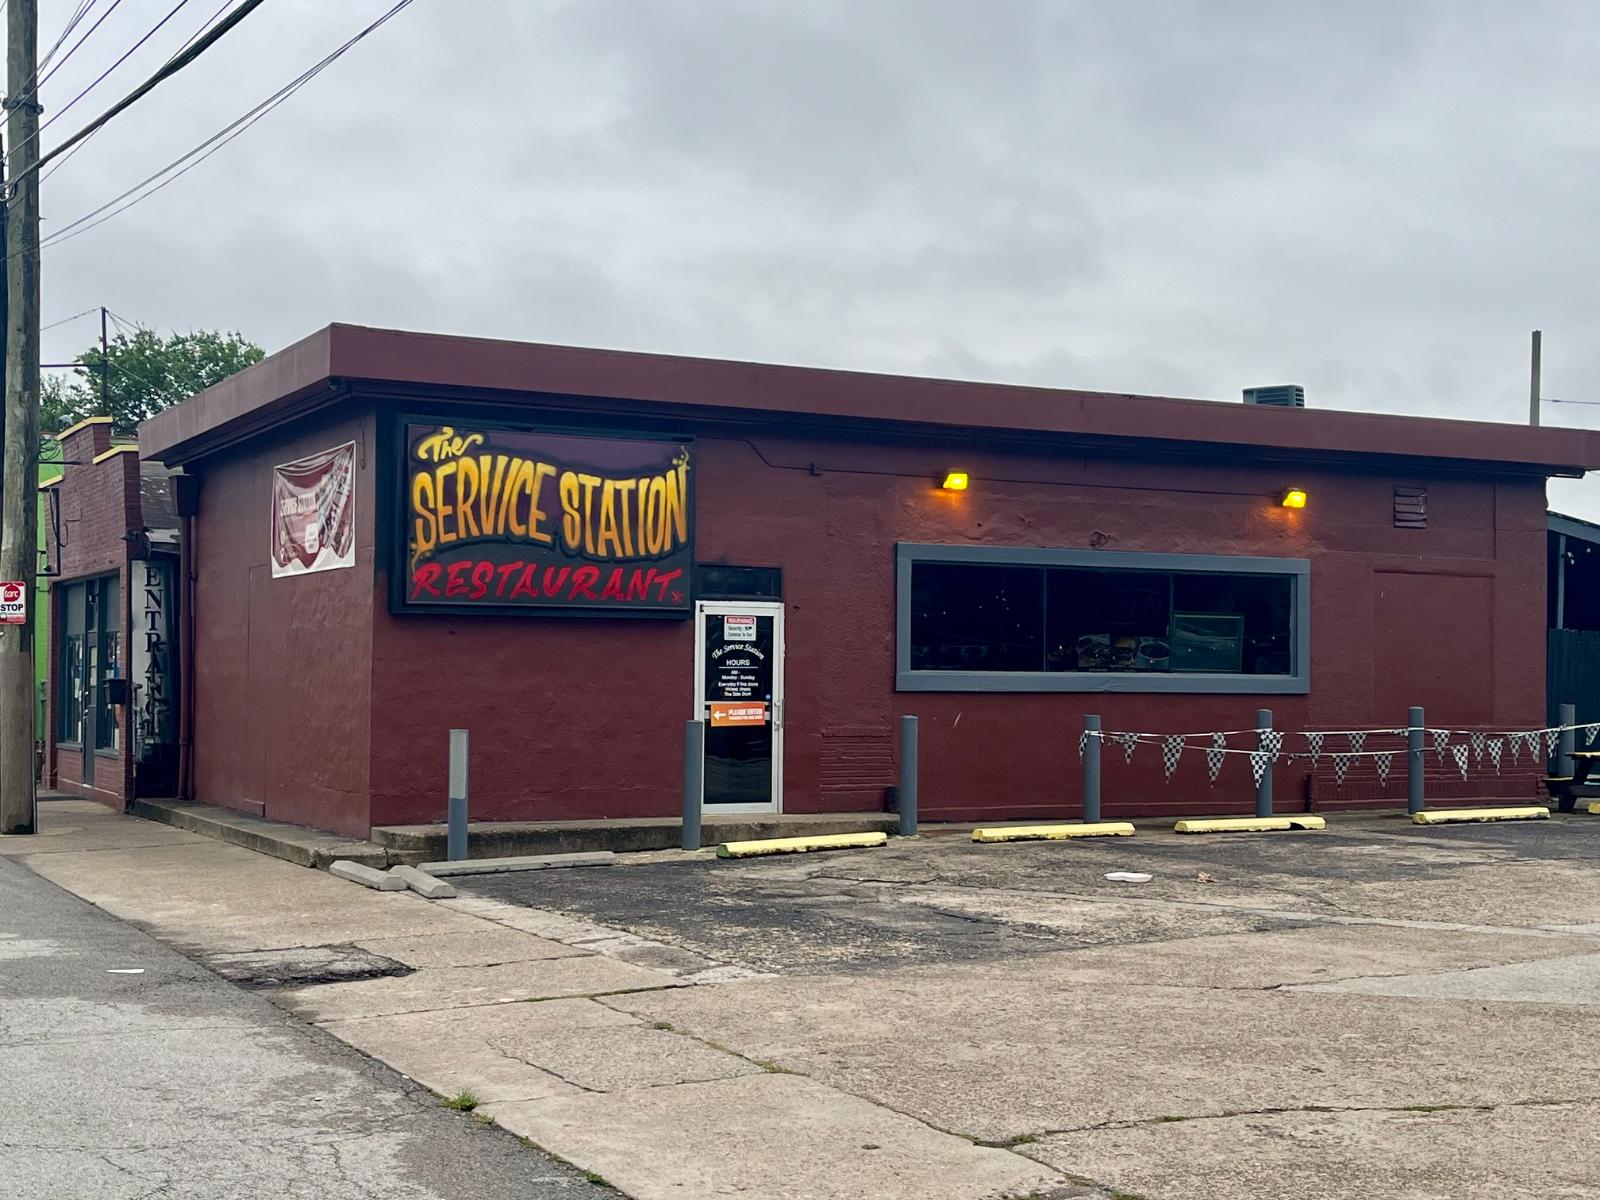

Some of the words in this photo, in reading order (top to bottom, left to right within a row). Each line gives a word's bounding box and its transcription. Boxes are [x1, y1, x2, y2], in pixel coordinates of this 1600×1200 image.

[418, 426, 483, 462] The
[413, 454, 557, 552] SERVICE
[560, 464, 688, 558] STATION
[4, 590, 18, 598] tarc
[411, 561, 683, 601] RESTAURANT
[712, 648, 723, 659] The
[723, 645, 744, 653] Service
[744, 644, 764, 660] Station
